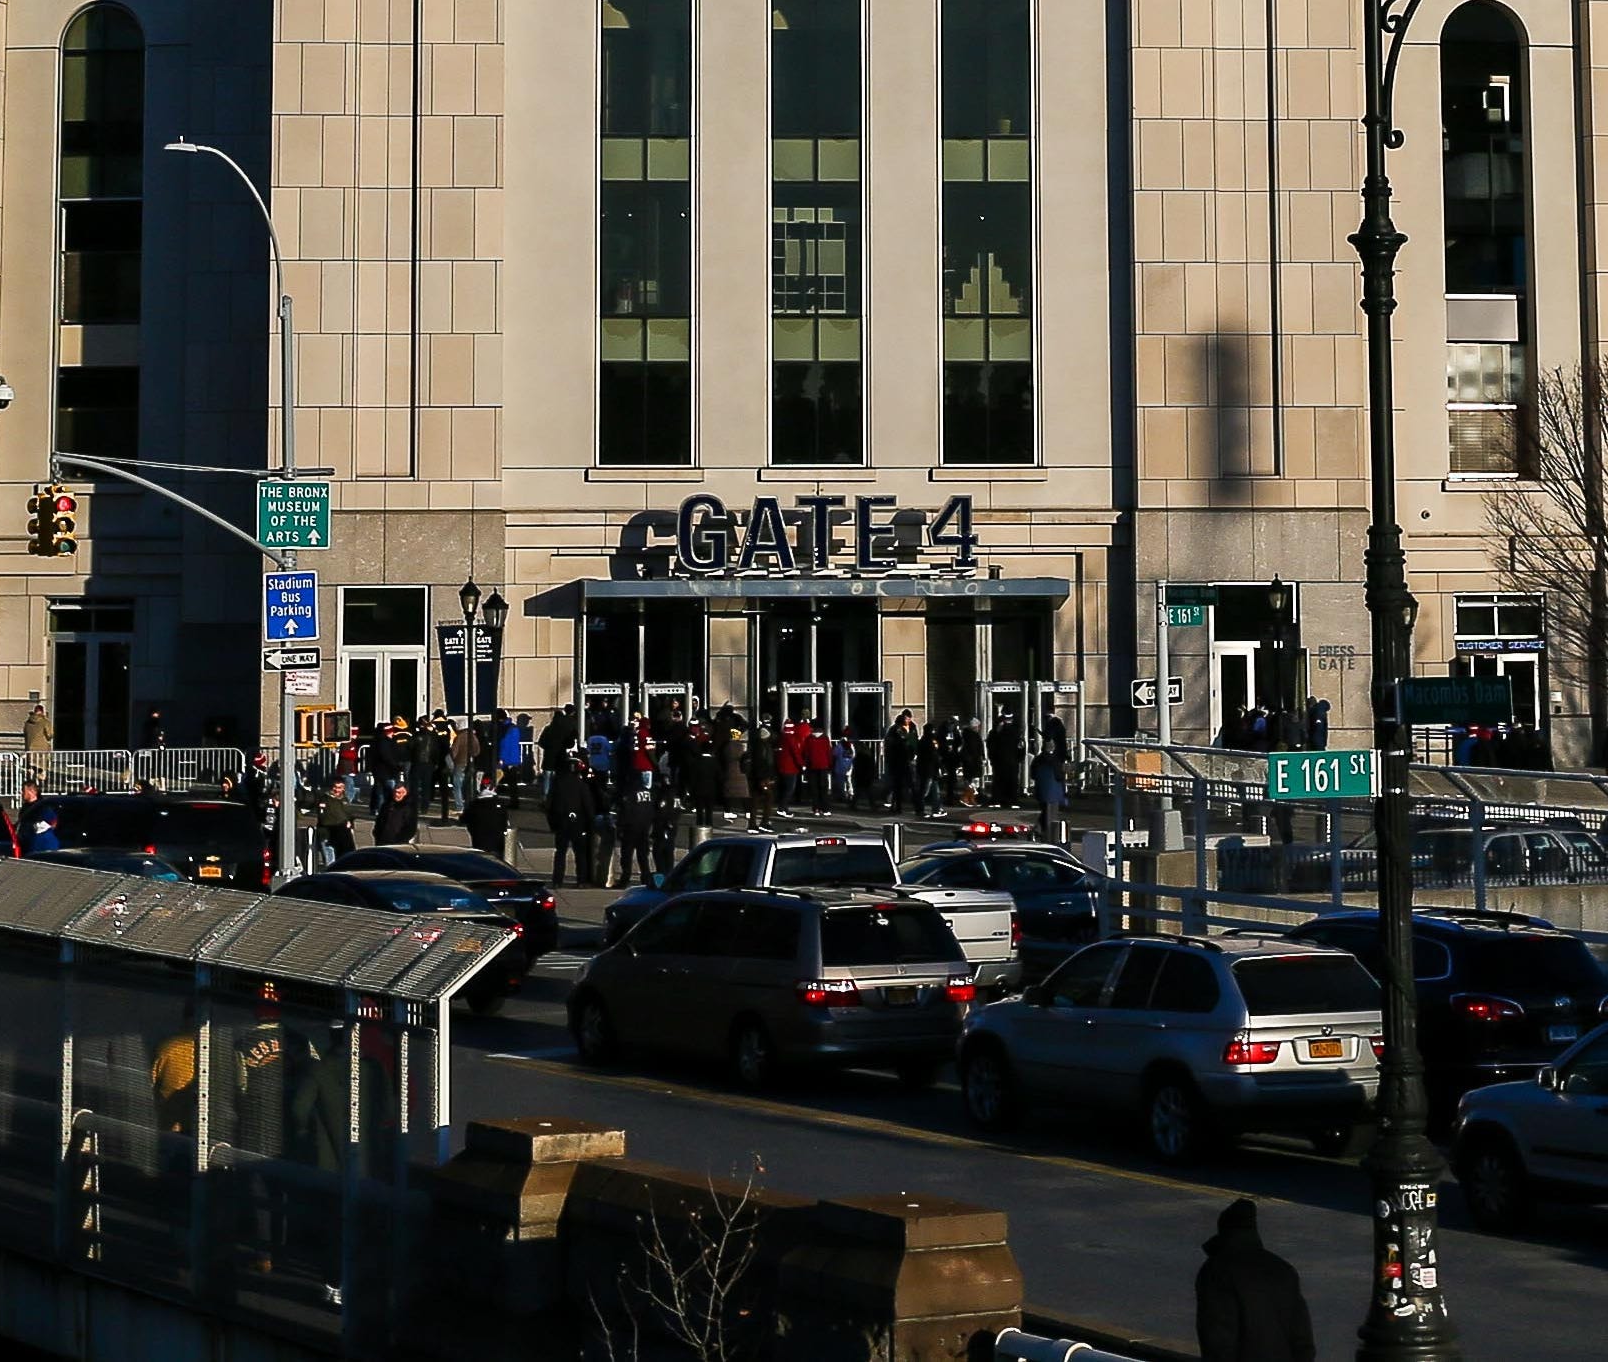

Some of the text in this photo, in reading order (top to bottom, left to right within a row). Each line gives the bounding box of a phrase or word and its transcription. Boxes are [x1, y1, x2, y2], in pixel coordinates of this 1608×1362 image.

[260, 486, 328, 499] THE BRONX
[267, 501, 320, 513] MUSEUM
[270, 515, 317, 527] OF THE
[266, 531, 300, 543] ARTS
[676, 493, 980, 573] GATE 4
[268, 577, 313, 591] Stadium
[281, 591, 301, 603] Bus
[270, 603, 312, 619] Parking
[1168, 608, 1175, 624] E
[1177, 608, 1192, 624] 161
[1319, 645, 1354, 657] PRESS
[1456, 640, 1545, 650] CUSTOMER SERVICE
[281, 654, 315, 664] ONE WAY
[1319, 658, 1355, 670] GATE
[1404, 679, 1507, 705] Macombs Dam
[1277, 754, 1366, 793] E 161 St
